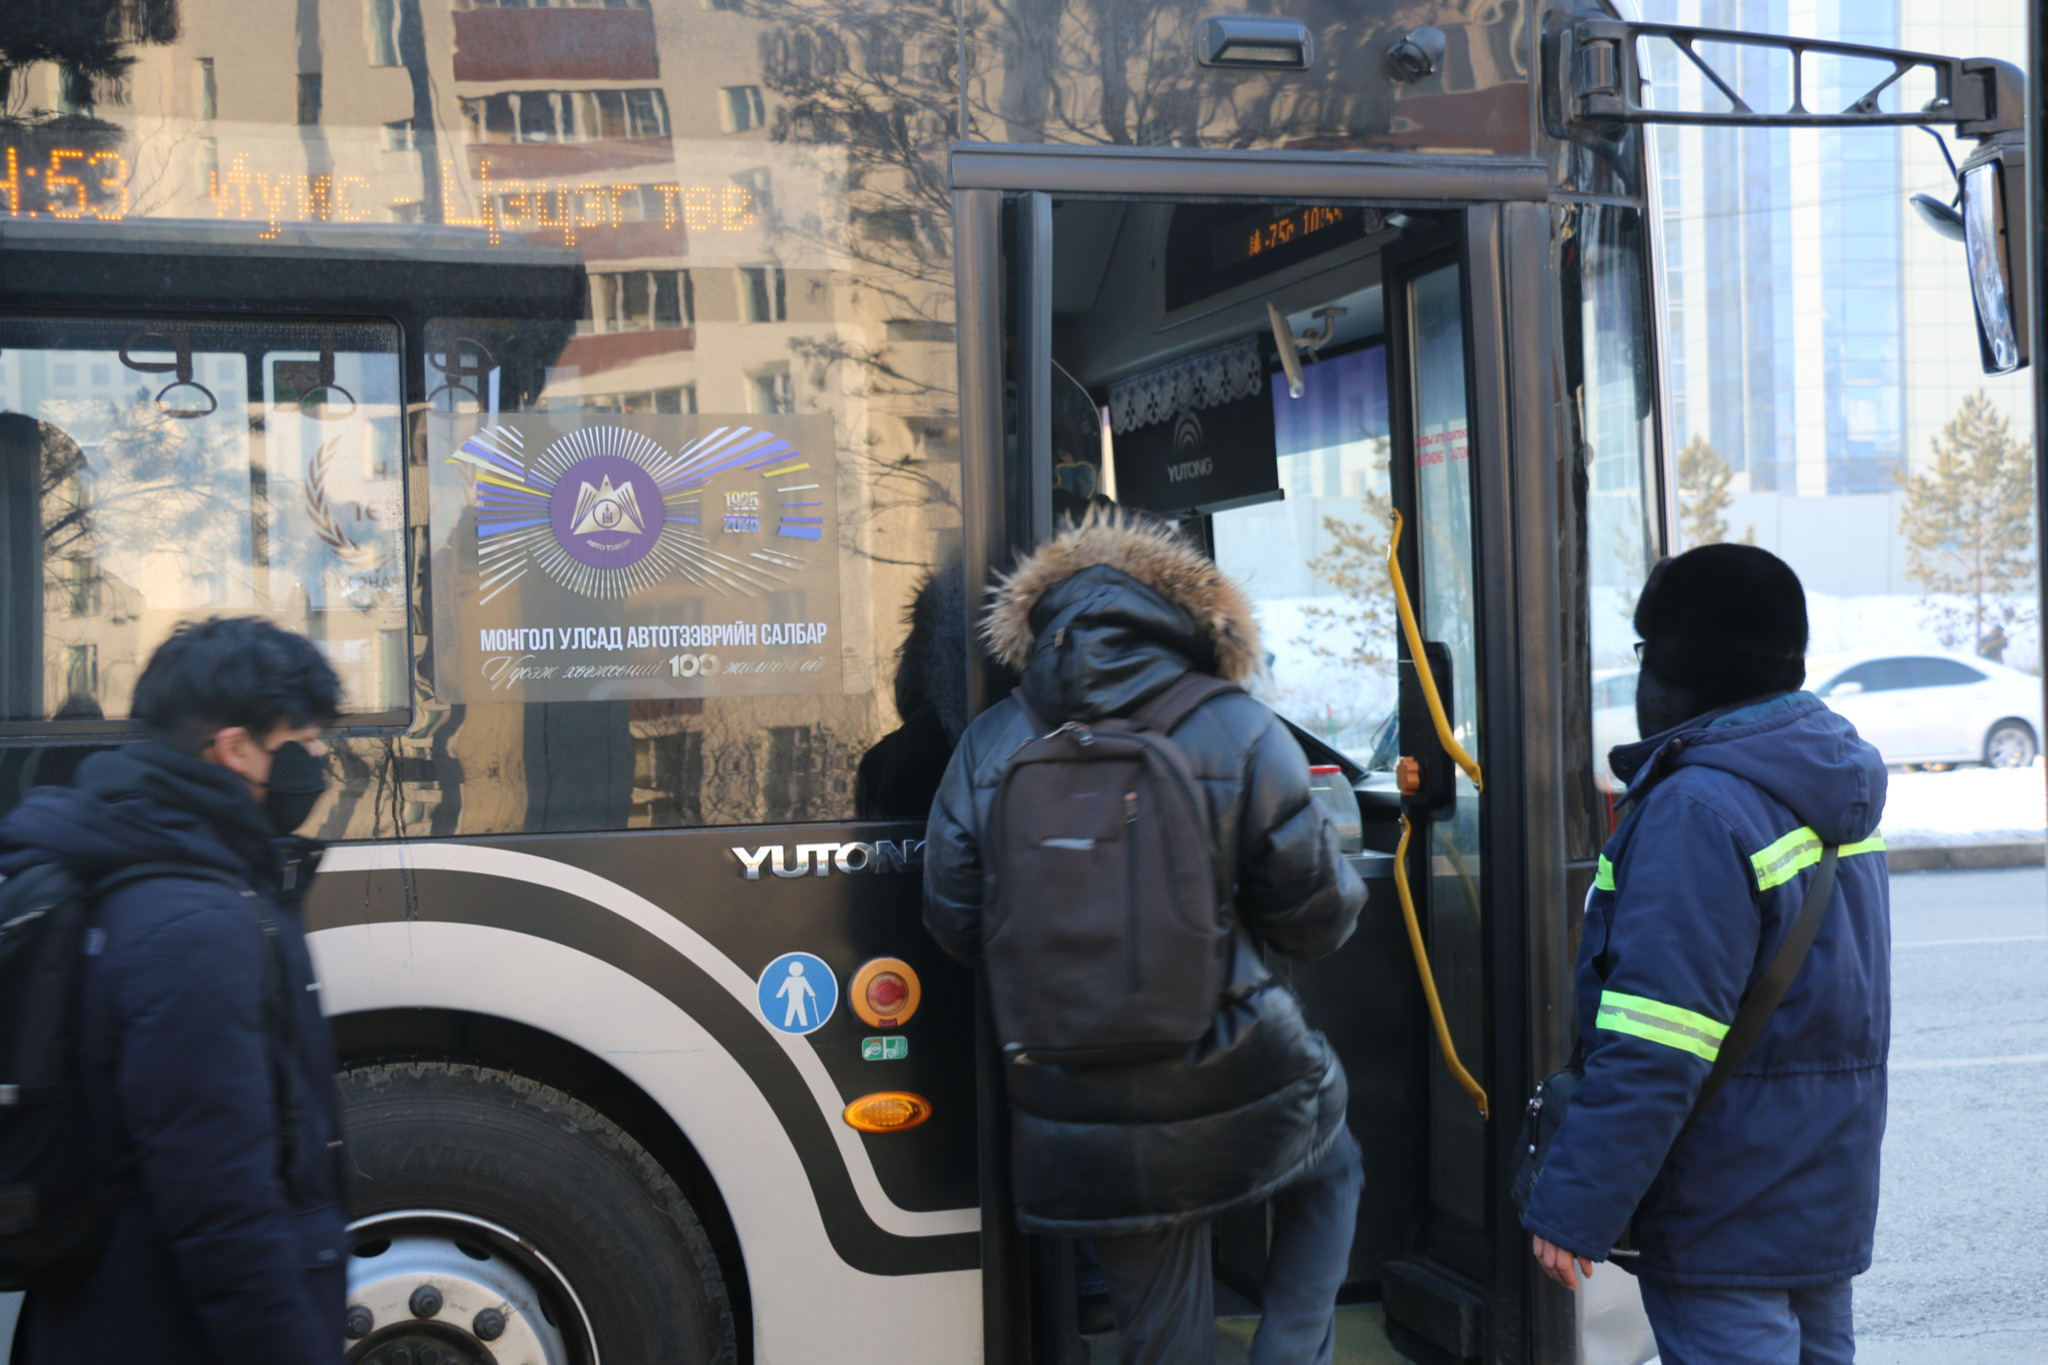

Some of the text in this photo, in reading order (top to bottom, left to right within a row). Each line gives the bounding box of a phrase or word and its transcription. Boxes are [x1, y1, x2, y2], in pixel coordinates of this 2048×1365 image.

[1167, 457, 1213, 483] YUTONG
[725, 491, 759, 511] 1925
[723, 513, 760, 534] 2025
[480, 620, 828, 651] МОНГОЛ УЛСАД АВТОТЭЭВРИЙН САЛБАР
[669, 653, 721, 677] 100
[731, 839, 927, 880] YUTON
